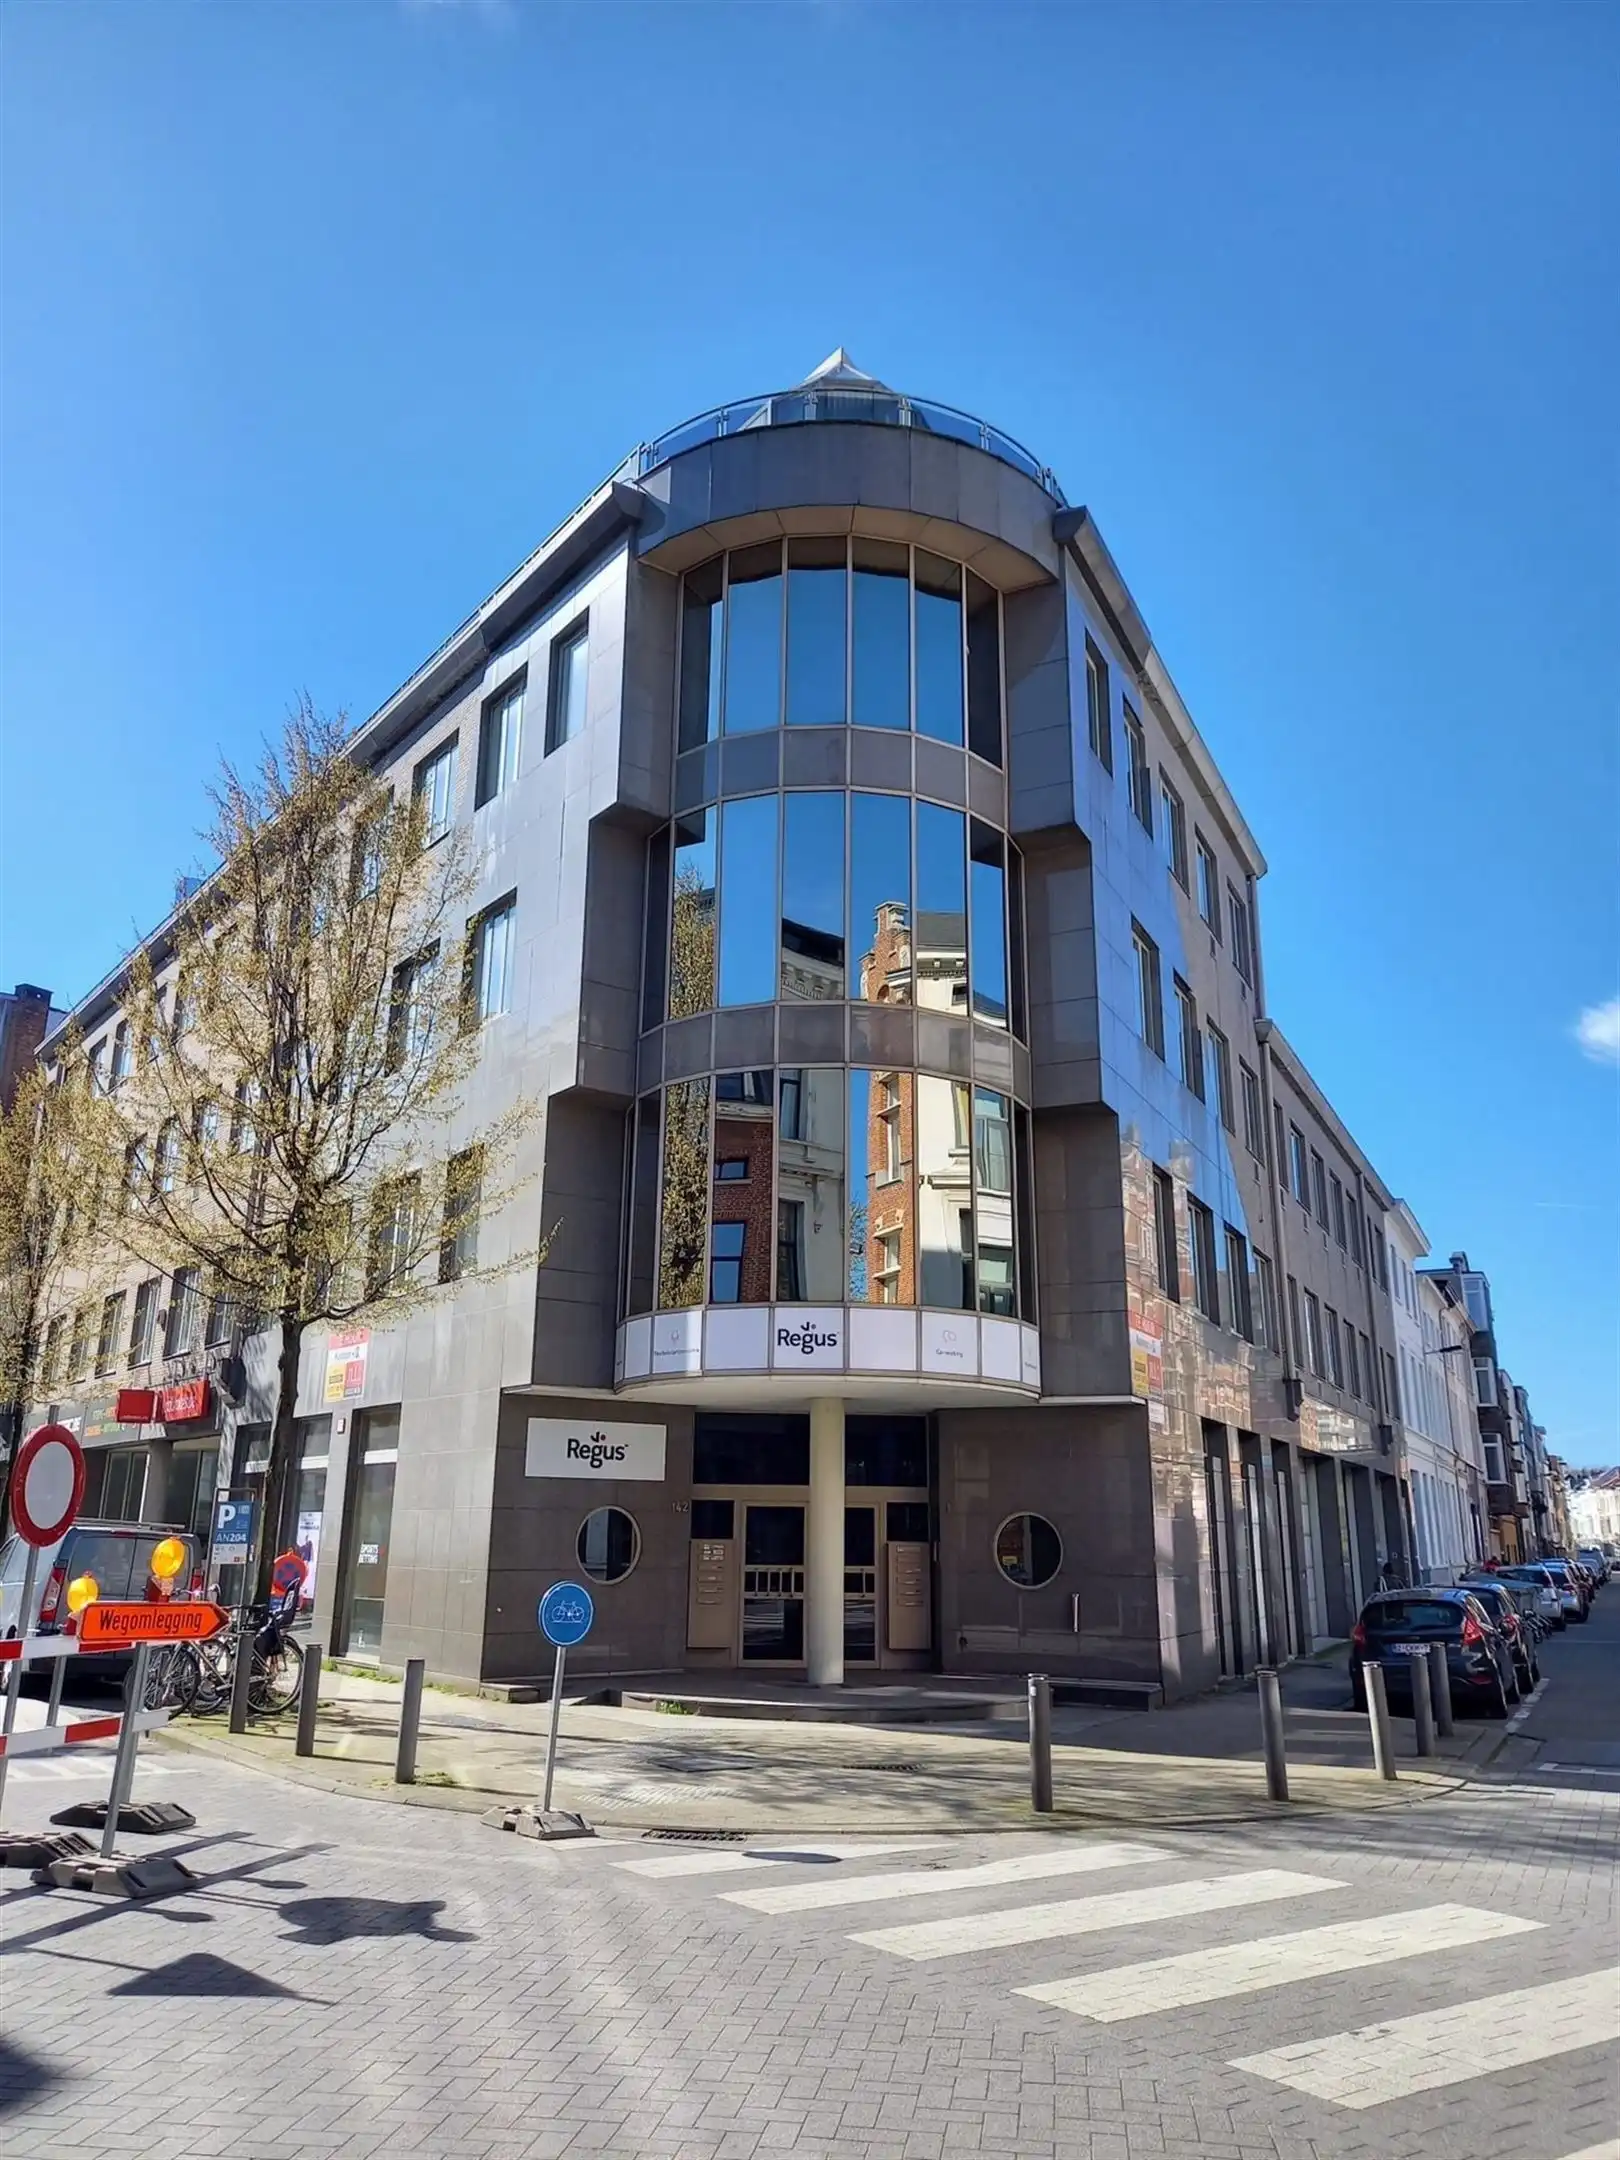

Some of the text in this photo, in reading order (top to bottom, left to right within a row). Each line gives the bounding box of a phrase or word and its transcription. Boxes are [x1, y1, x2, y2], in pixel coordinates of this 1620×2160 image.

[776, 1328, 838, 1355] Regus
[567, 1438, 626, 1469] Regus
[217, 1504, 236, 1529] P
[672, 1502, 689, 1513] 142
[216, 1533, 247, 1543] AN204
[100, 1609, 202, 1636] Wegomlegging
